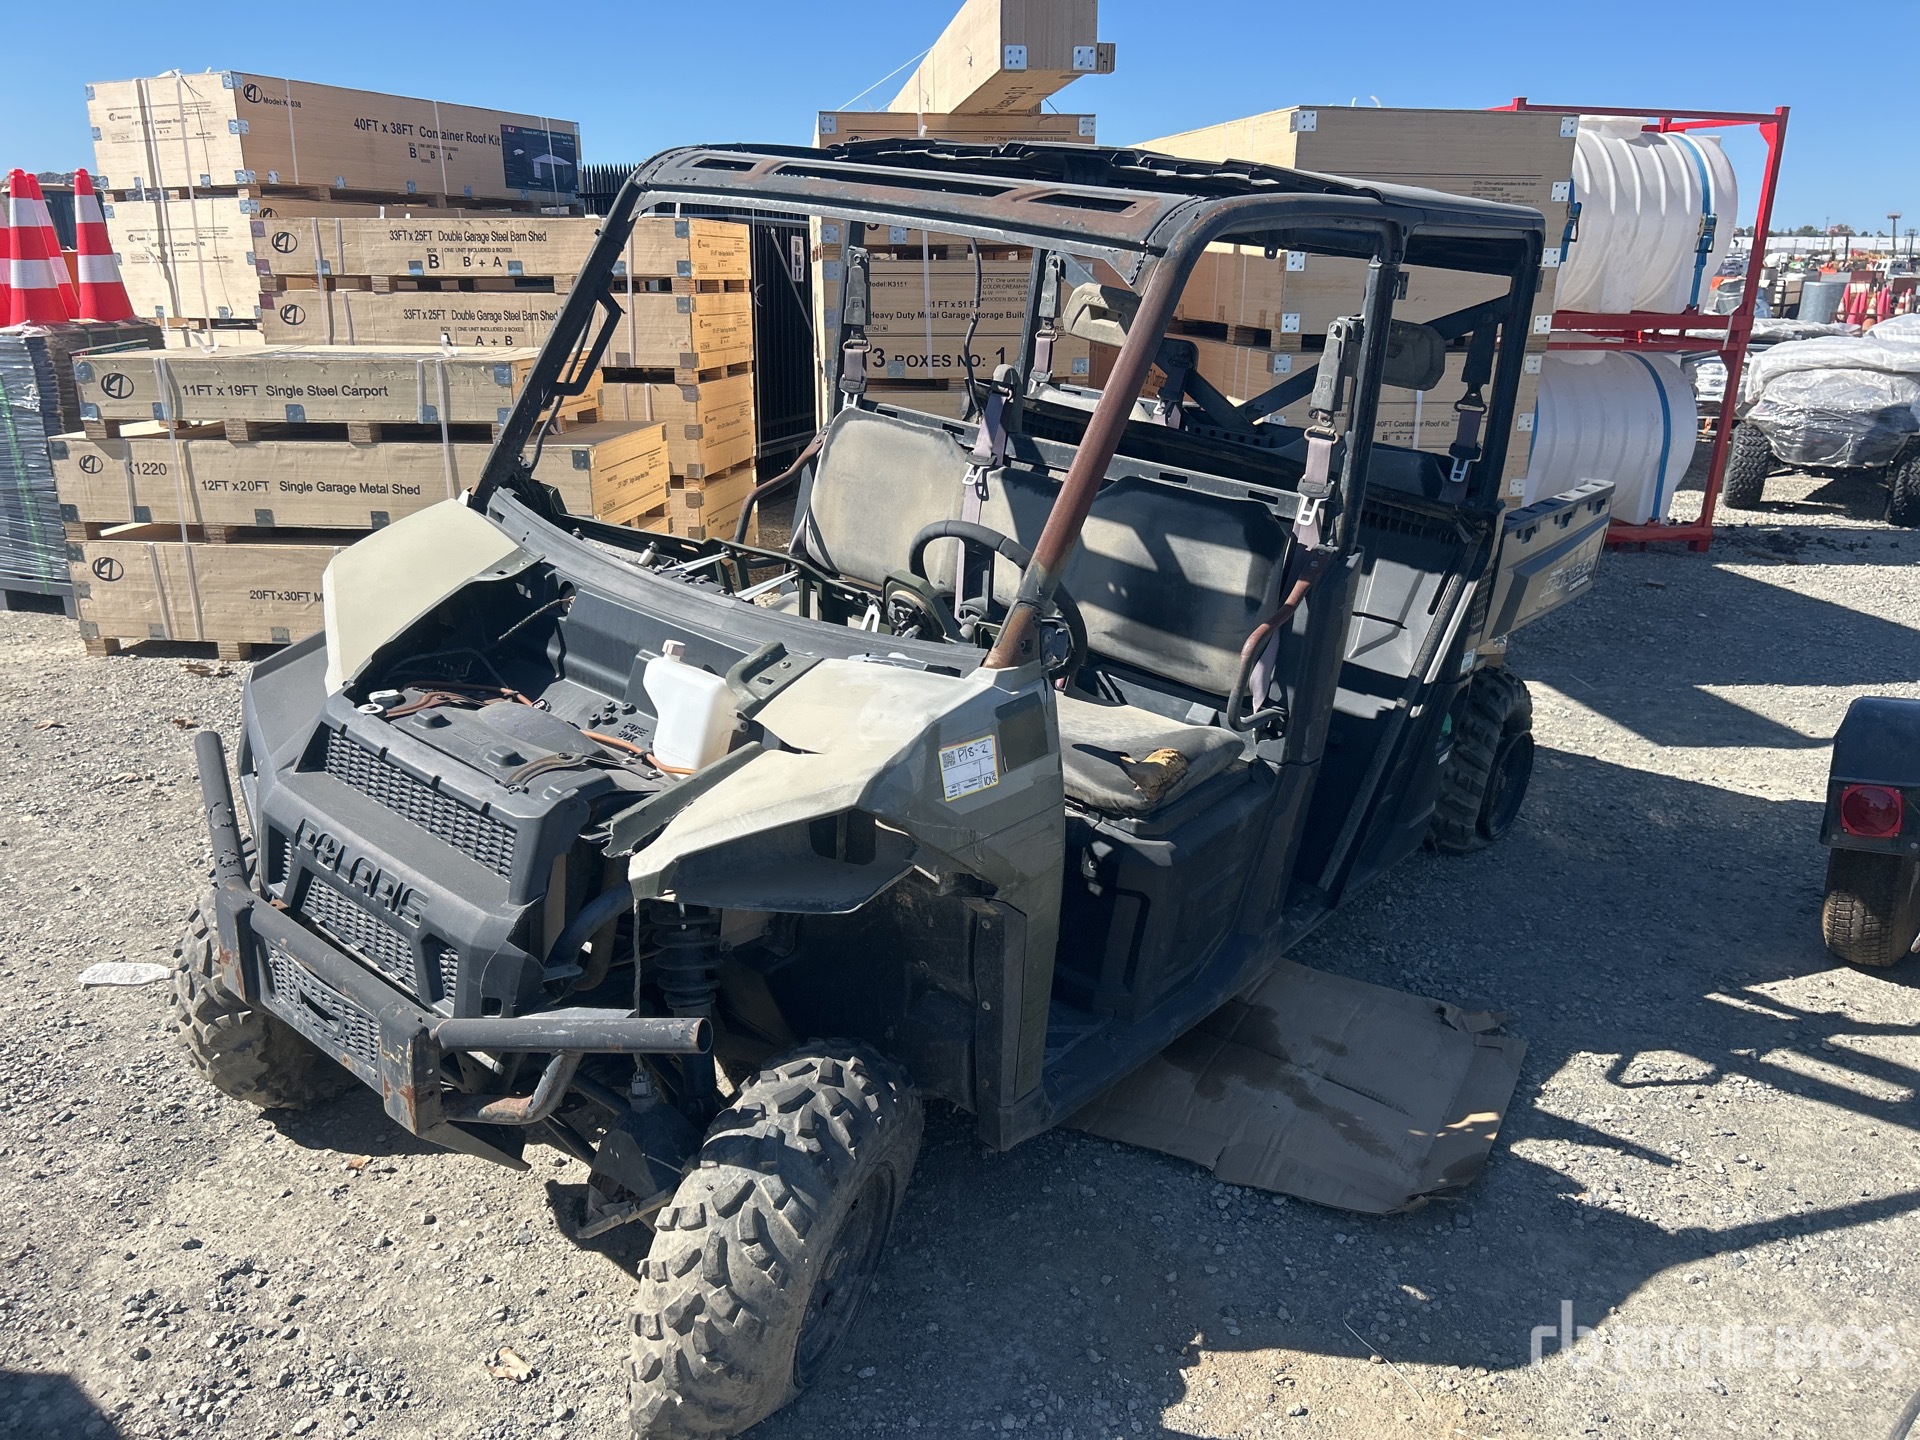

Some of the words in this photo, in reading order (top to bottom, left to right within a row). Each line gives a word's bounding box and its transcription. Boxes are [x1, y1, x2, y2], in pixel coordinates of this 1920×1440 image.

[354, 117, 378, 132] 40FT
[390, 122, 414, 136] 38FT
[466, 131, 486, 144] Roof
[488, 134, 501, 146] Kit
[410, 147, 417, 158] B
[430, 151, 436, 160] B
[448, 153, 453, 161] A
[390, 230, 407, 242] 33FT
[414, 230, 432, 242] 25FT
[438, 230, 462, 242] Double
[464, 231, 490, 244] Garage
[491, 231, 508, 242] Steel
[510, 231, 527, 242] Barn
[528, 231, 546, 242] Shed
[428, 254, 440, 269] B
[463, 256, 472, 267] B
[493, 256, 502, 267] A
[404, 309, 421, 320] 33FT
[428, 309, 446, 320] 25FT
[452, 310, 476, 320] Double
[477, 310, 502, 323] Garage
[504, 310, 521, 321] Steel
[522, 310, 538, 321] Barn
[540, 310, 558, 321] Shed
[870, 312, 894, 320] Heavy
[897, 312, 915, 320] Duty
[942, 312, 970, 320] Garage
[973, 312, 1004, 320] torage
[476, 336, 484, 346] A
[505, 336, 514, 346] B
[872, 348, 886, 368] 3
[996, 347, 1005, 364] 1
[182, 385, 212, 396] 11FT
[217, 388, 224, 396] x
[228, 385, 258, 396] 19FT
[266, 385, 304, 398] Single
[307, 385, 338, 396] Steel
[342, 386, 388, 399] Carport
[1394, 420, 1424, 428] Contair
[1382, 434, 1388, 442] B
[202, 480, 230, 492] 12FT
[280, 480, 312, 494] Single
[316, 482, 356, 496] Garage
[360, 482, 388, 494] Metal
[392, 483, 420, 496] Shed
[250, 590, 310, 602] 20FTx30FT
[295, 818, 430, 928] POLARIS
